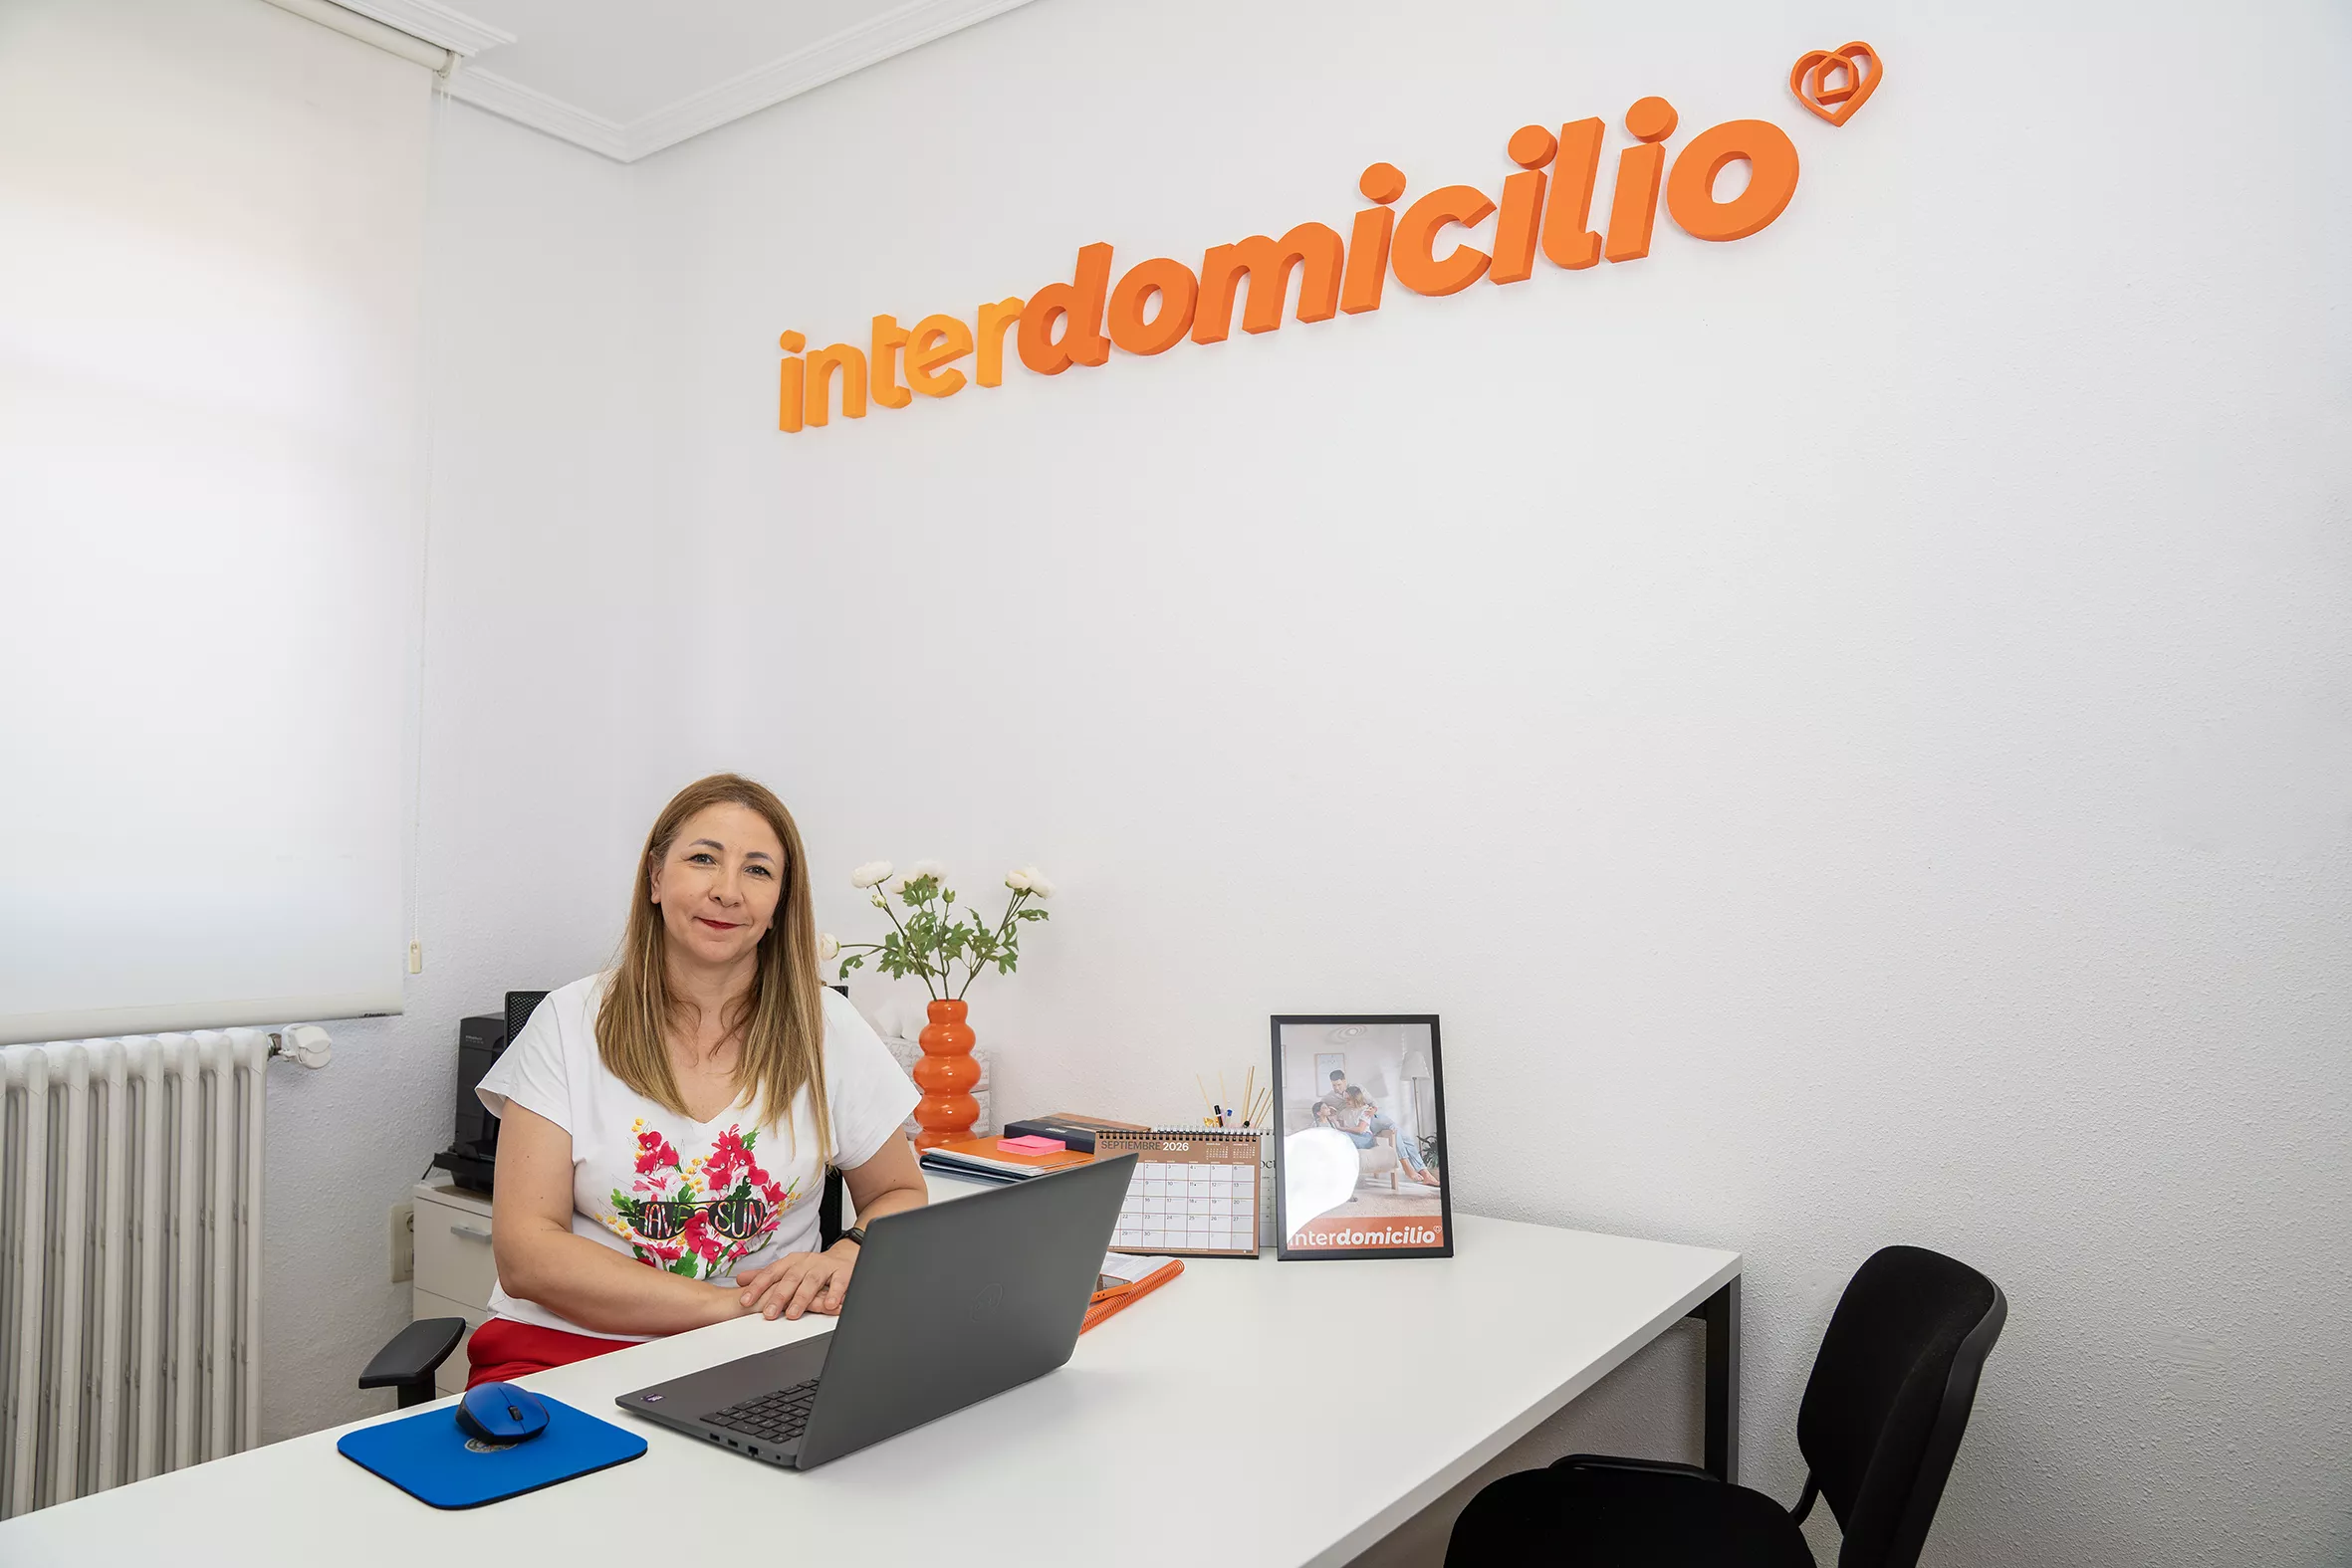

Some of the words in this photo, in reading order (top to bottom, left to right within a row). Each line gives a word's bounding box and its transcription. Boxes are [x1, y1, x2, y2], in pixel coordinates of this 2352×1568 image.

[780, 97, 1800, 433] interdomicilio
[1101, 1140, 1161, 1151] SEPTIEMBRE
[1162, 1142, 1189, 1152] 2026
[714, 1201, 765, 1238] SUN
